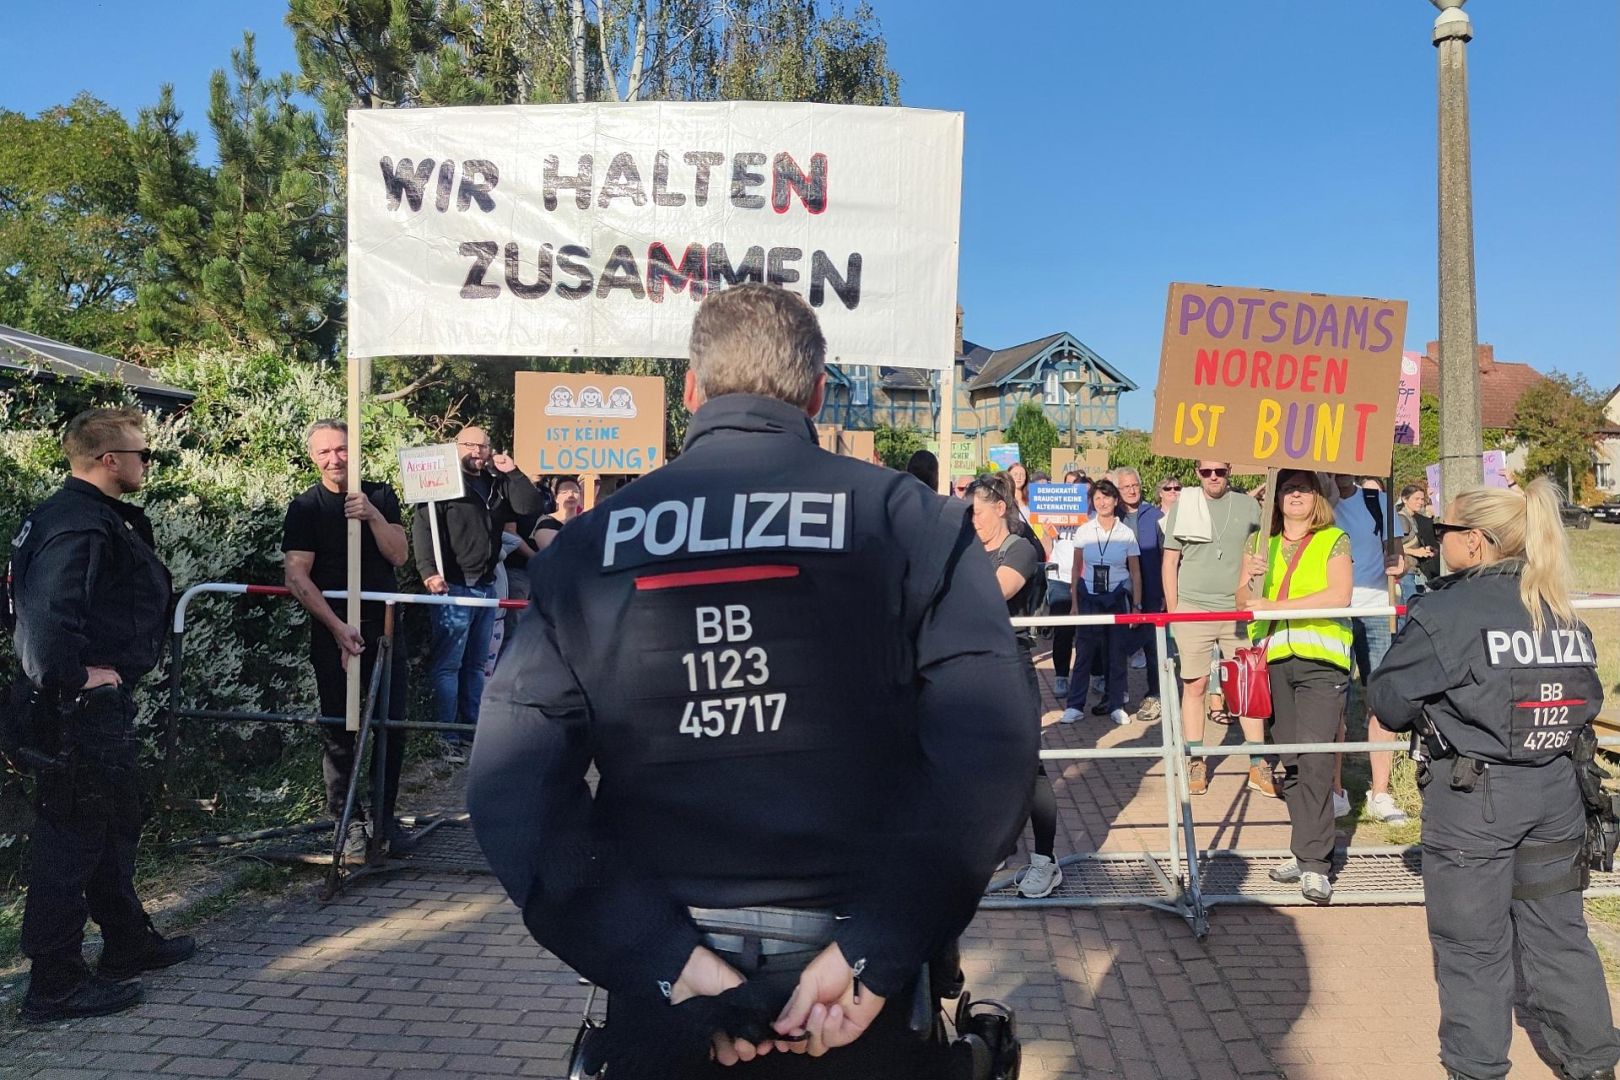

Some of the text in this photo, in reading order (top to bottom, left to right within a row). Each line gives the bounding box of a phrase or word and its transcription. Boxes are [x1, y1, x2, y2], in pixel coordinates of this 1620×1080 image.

[380, 148, 828, 214] WIR HALTEN
[459, 241, 863, 310] ZUSAMMEN
[1179, 294, 1395, 353] POTSDAMS
[1194, 348, 1348, 395] NORDEN
[546, 427, 620, 441] IST KEINE
[1173, 402, 1225, 447] IST
[1253, 398, 1378, 463] BUNT
[540, 444, 657, 470] LÖSUNG!
[602, 492, 846, 567] POLIZEI
[696, 605, 753, 644] BB
[682, 647, 770, 691] 1123
[1540, 683, 1563, 702] BB
[679, 693, 787, 738] 45717
[1533, 706, 1569, 726] 1122
